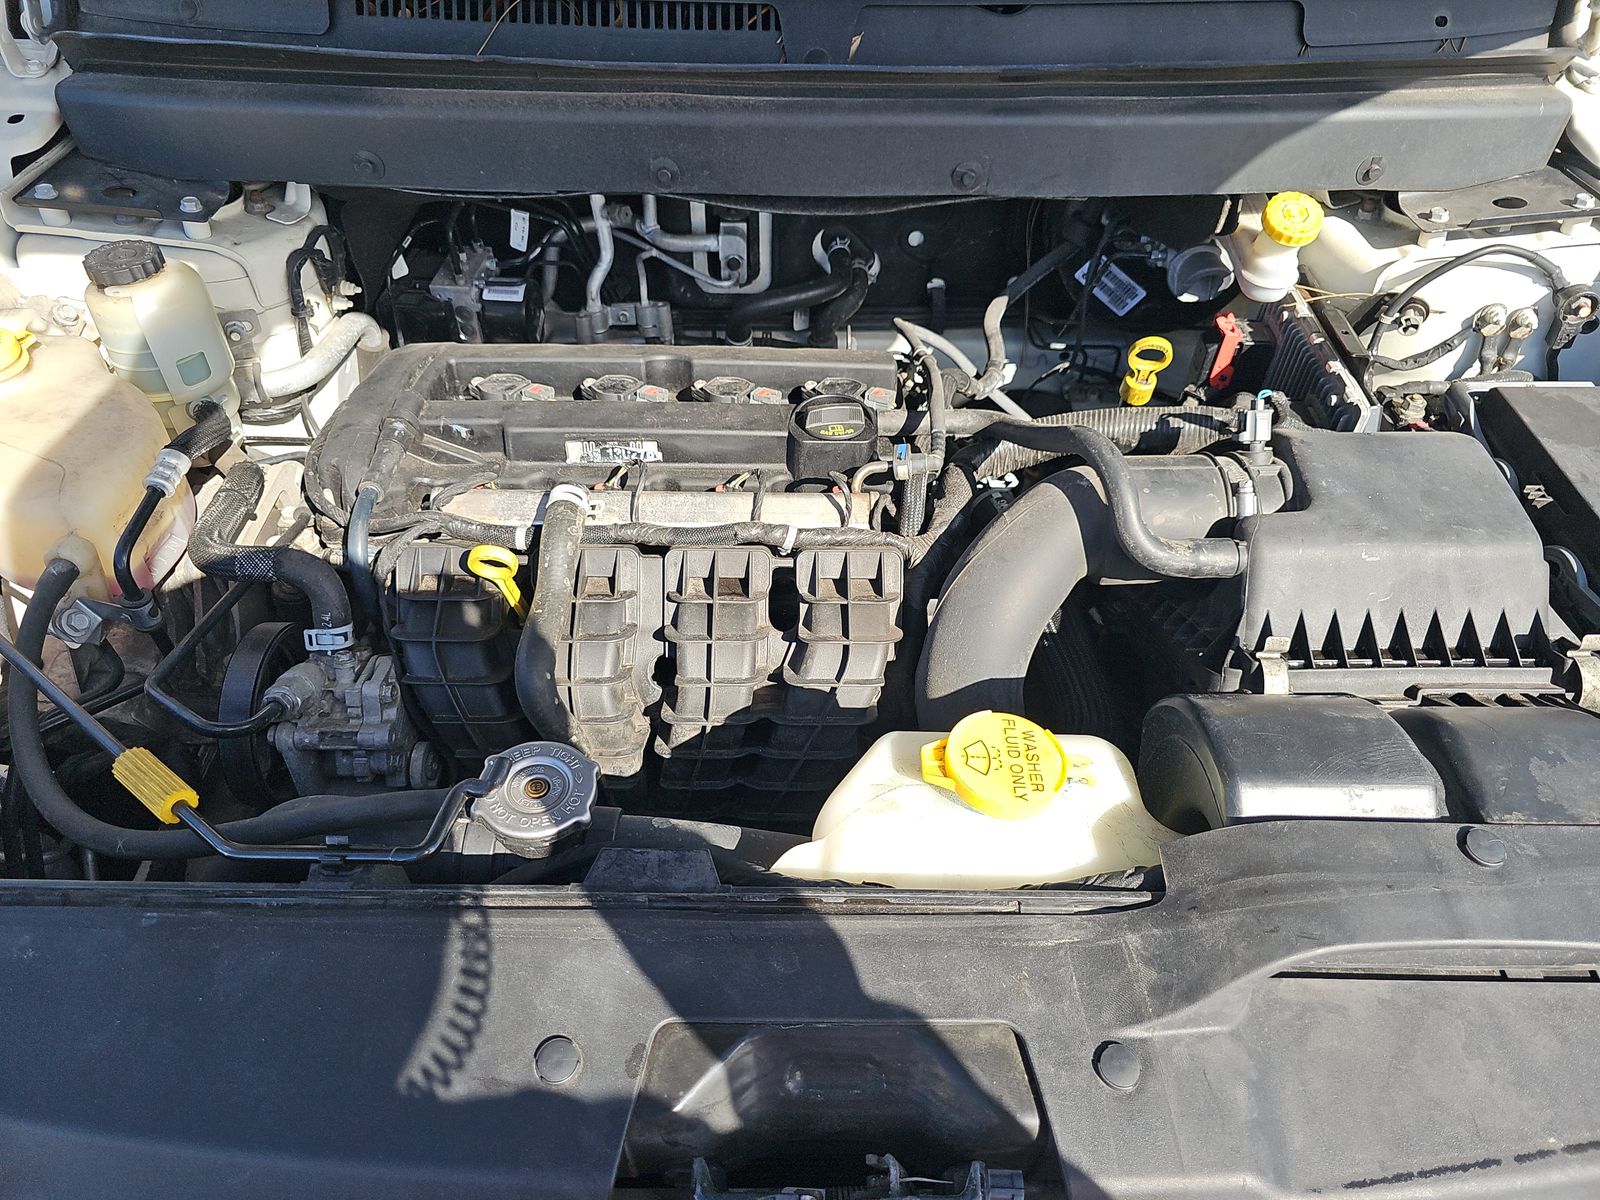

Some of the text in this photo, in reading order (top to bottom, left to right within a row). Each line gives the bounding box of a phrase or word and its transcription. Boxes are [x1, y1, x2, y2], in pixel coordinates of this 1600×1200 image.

[509, 746, 584, 770] EEP TIGHT
[1002, 718, 1029, 802] FLUID ONLY
[1022, 730, 1045, 793] WASHER
[489, 802, 517, 824] NOT
[520, 812, 562, 828] OPEN
[560, 789, 585, 815] HOT
